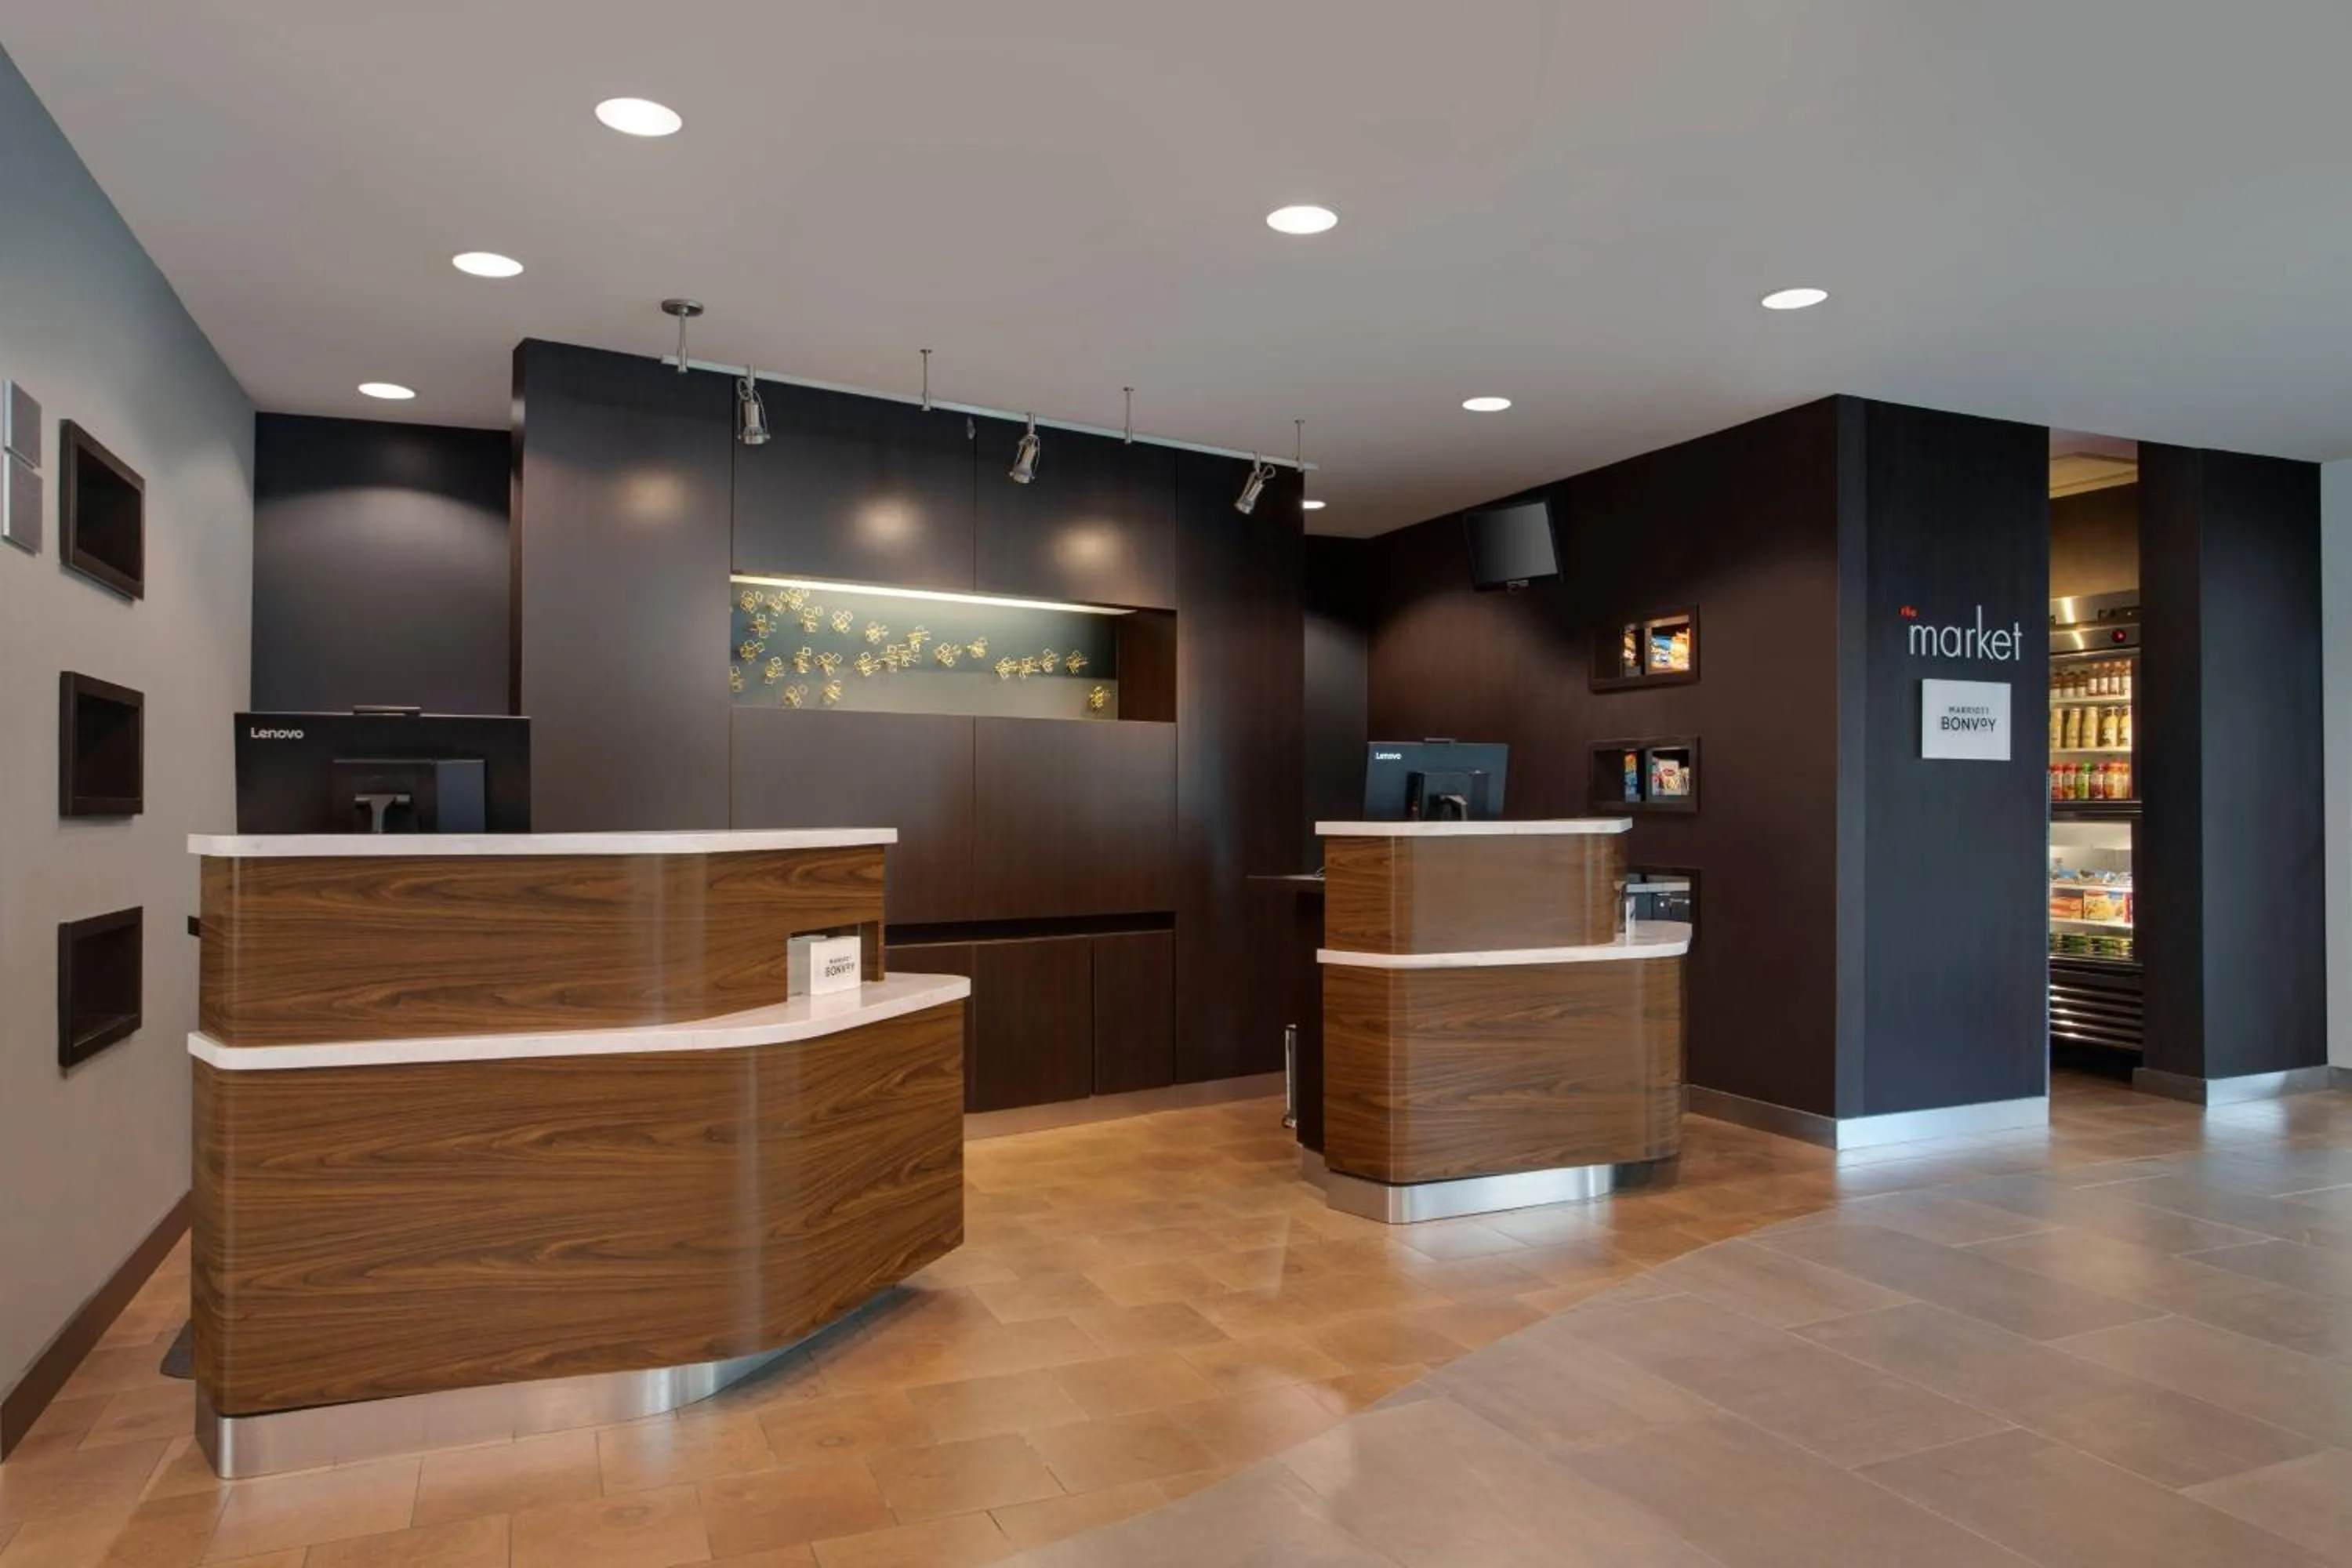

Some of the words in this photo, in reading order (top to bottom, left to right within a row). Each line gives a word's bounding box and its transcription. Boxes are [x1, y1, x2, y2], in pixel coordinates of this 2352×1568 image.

[1909, 604, 2023, 661] market
[1941, 716, 1997, 732] BONVOY
[250, 727, 304, 739] Lenovo
